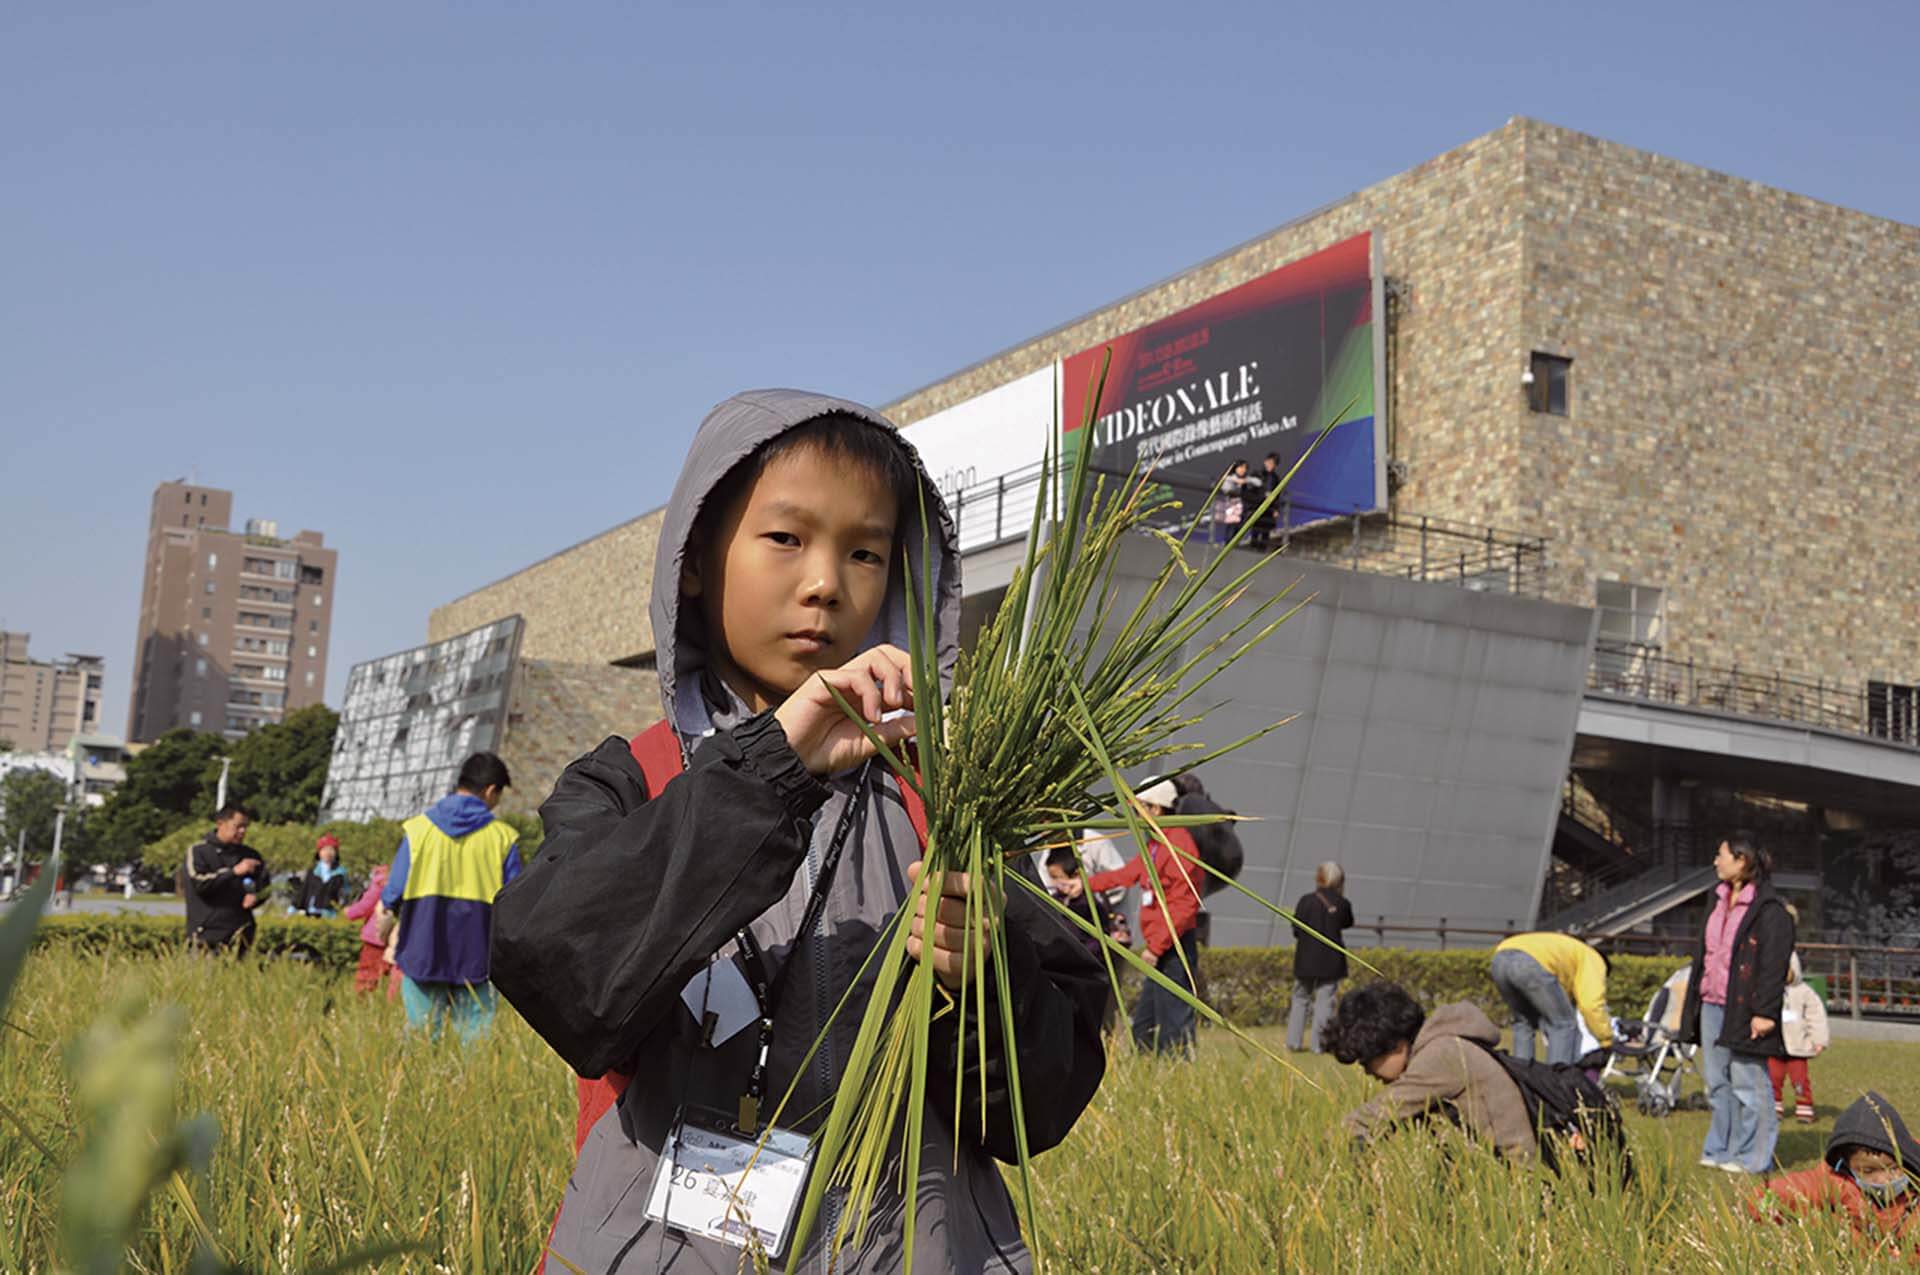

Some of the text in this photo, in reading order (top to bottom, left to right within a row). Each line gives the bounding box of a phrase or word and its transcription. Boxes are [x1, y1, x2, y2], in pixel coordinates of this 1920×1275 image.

[1175, 415, 1297, 463] in Contemporary Video Art
[670, 1164, 697, 1190] 26
